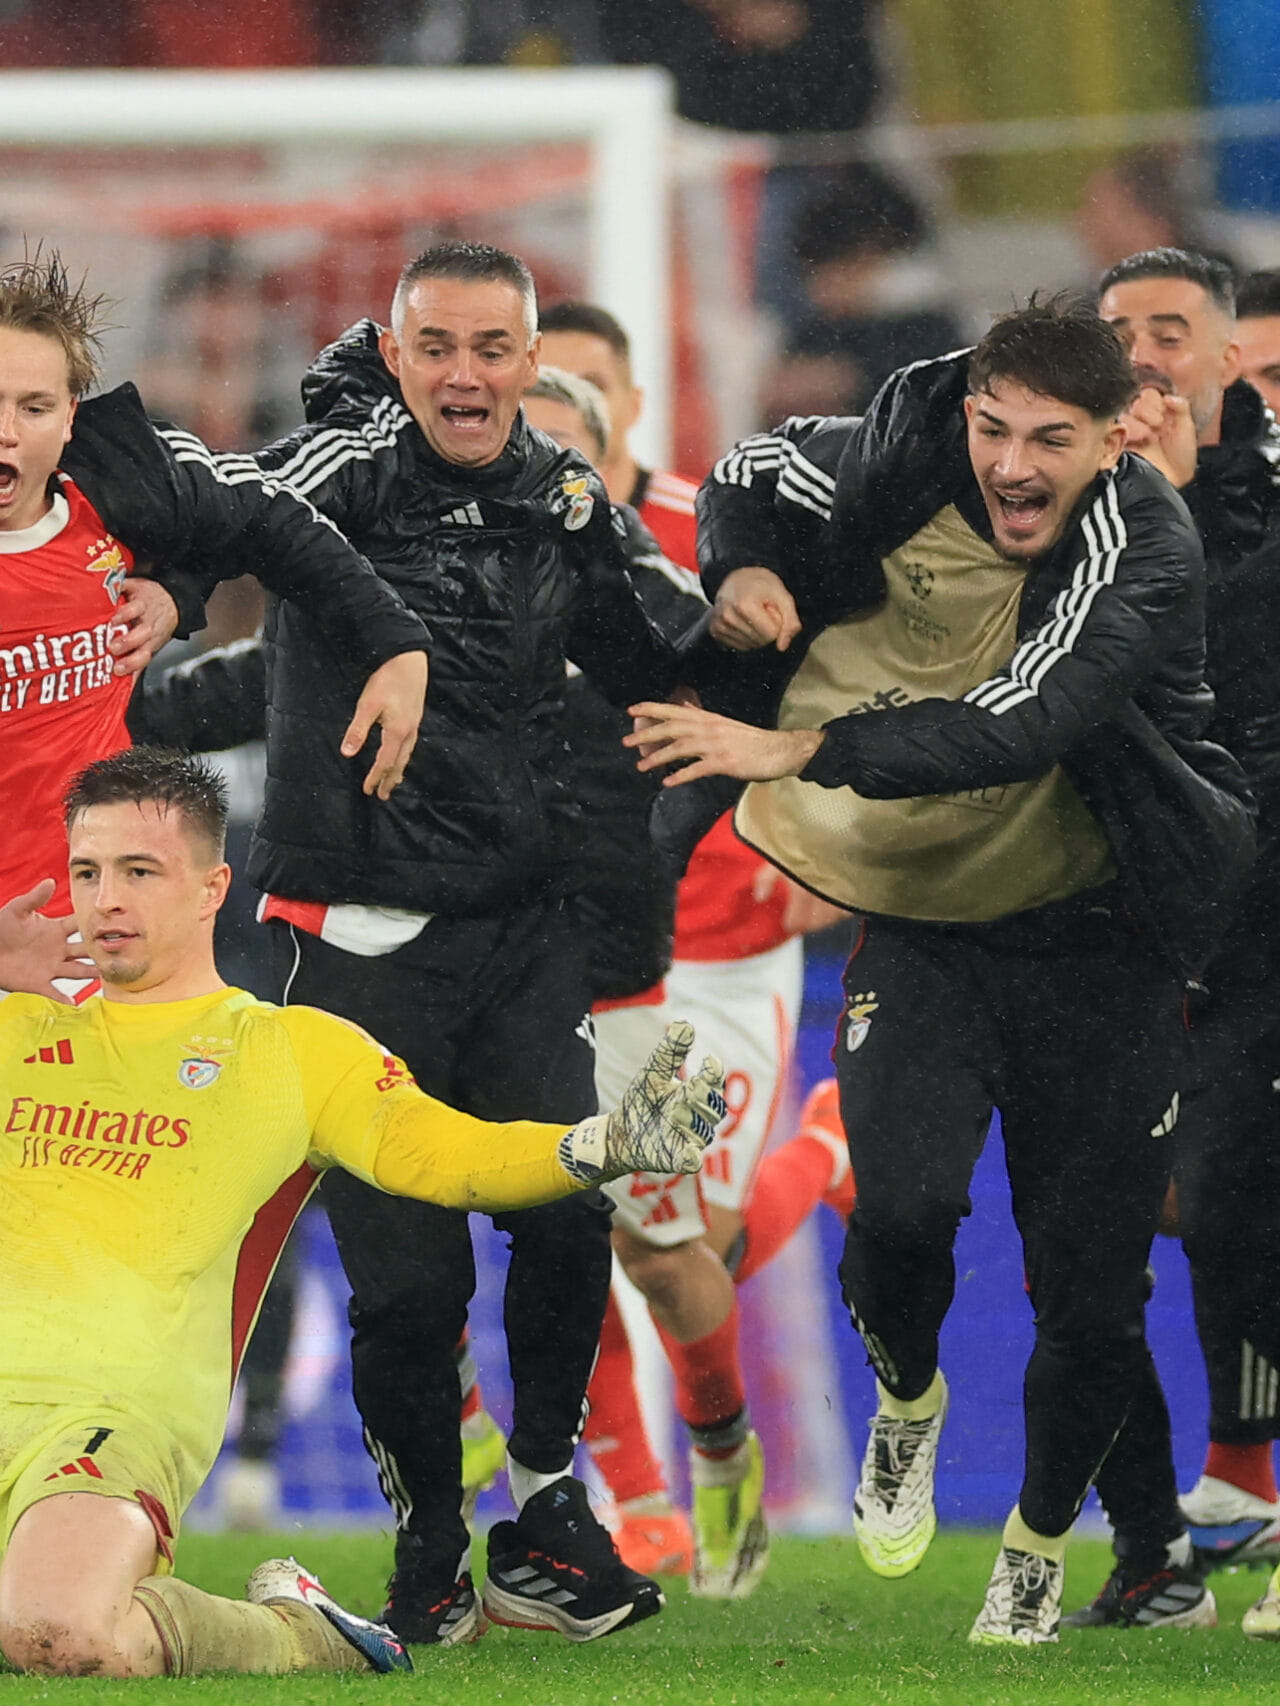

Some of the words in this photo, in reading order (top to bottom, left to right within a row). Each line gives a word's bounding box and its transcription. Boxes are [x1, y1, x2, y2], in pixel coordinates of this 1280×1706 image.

[5, 1096, 192, 1149] Emirates
[20, 1135, 59, 1169] FLY
[58, 1143, 152, 1181] BETTER
[83, 1426, 115, 1455] 1
